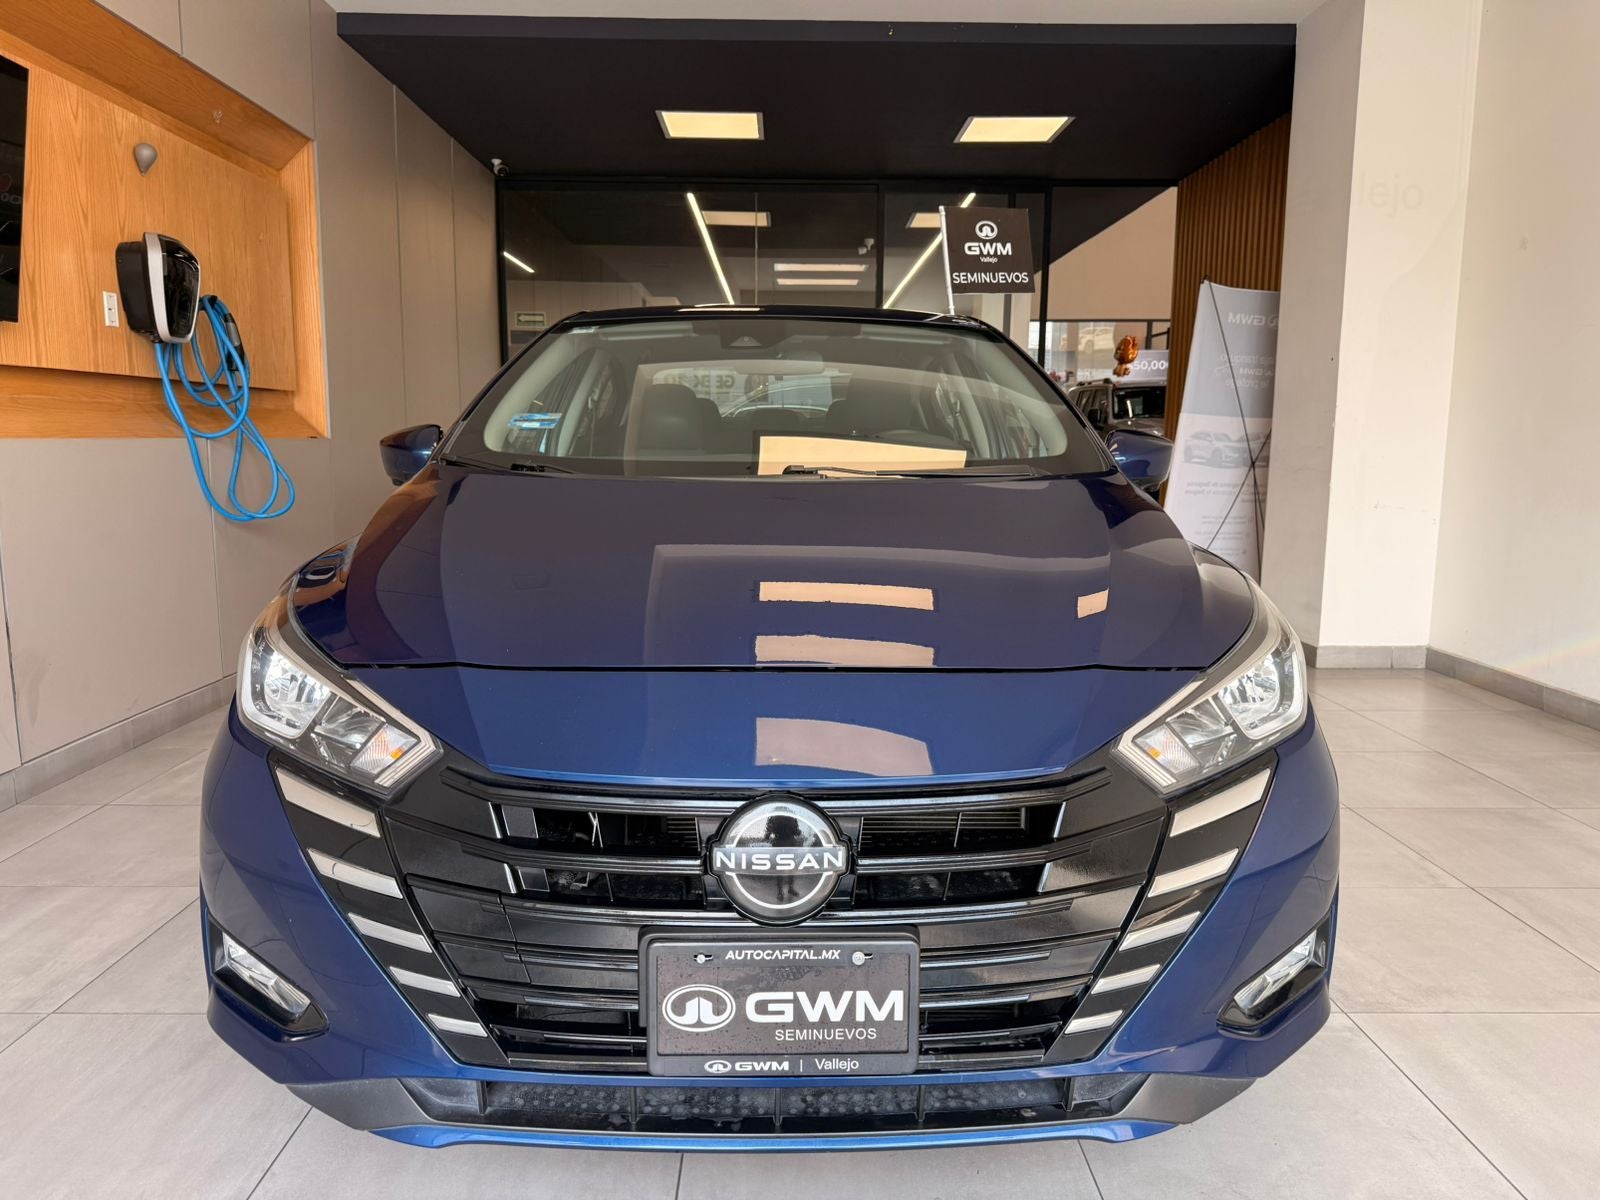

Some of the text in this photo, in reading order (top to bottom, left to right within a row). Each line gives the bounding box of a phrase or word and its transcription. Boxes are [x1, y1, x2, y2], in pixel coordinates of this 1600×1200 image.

[964, 241, 1012, 256] GWM
[979, 256, 998, 264] Vallejo
[952, 272, 1029, 284] SEMINUEVOS
[715, 850, 843, 871] NISSAN
[724, 949, 841, 961] AUTOCAPITAL.MX
[745, 990, 904, 1023] GWM
[774, 1027, 877, 1041] SEMINUEVOS
[734, 1057, 860, 1072] GWM Vallejo
